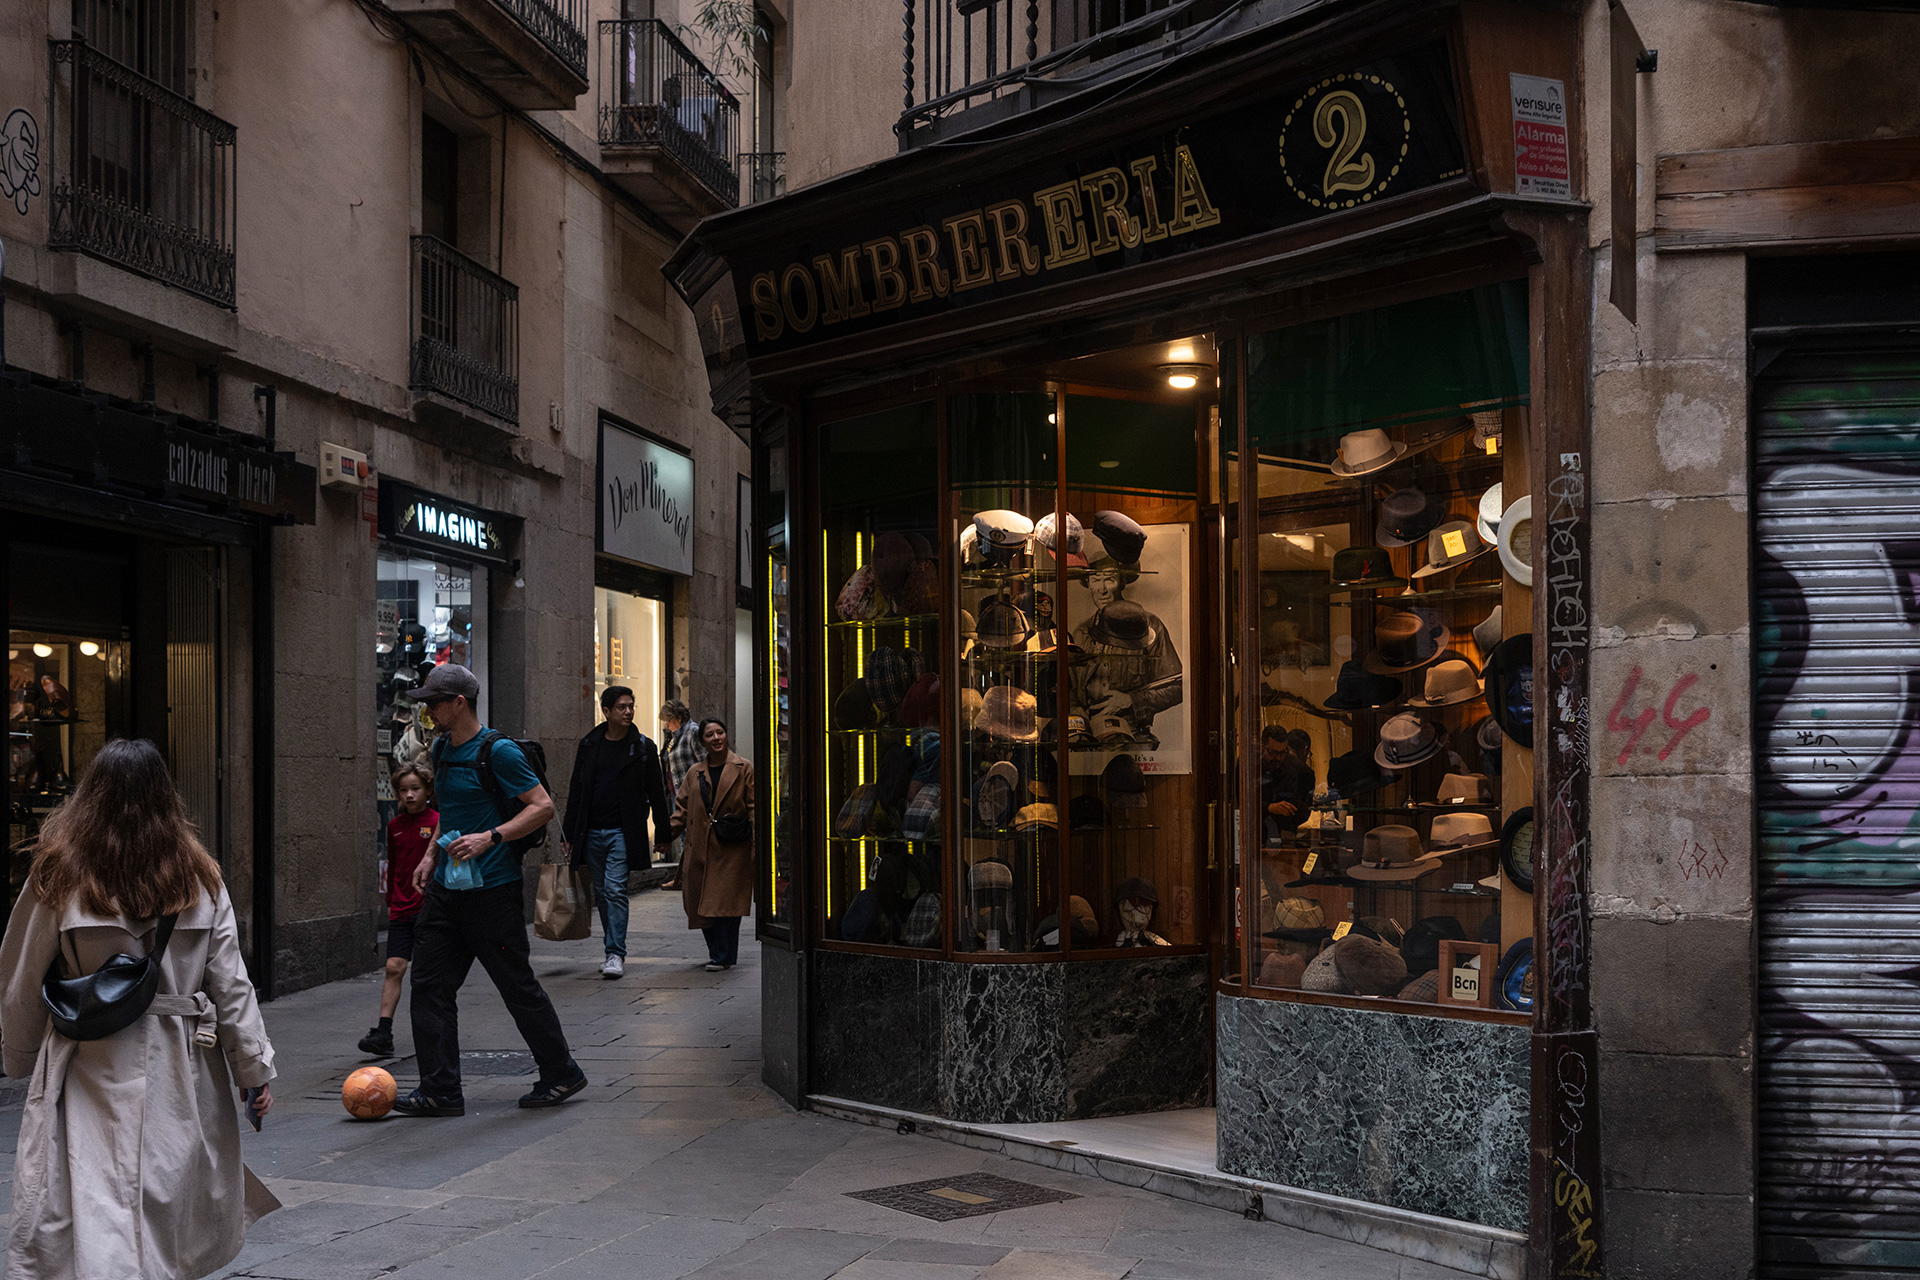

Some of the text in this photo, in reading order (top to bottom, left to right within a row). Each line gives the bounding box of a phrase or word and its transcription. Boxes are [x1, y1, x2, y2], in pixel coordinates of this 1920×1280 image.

[1514, 97, 1562, 113] verisure
[1312, 89, 1376, 199] 2
[1518, 162, 1538, 171] Aviso
[1545, 163, 1567, 175] Policía
[750, 145, 1220, 341] SOMBRERERIA
[416, 502, 488, 550] IMAGINE
[609, 459, 690, 555] Don Mineral
[1454, 975, 1477, 991] Bcn
